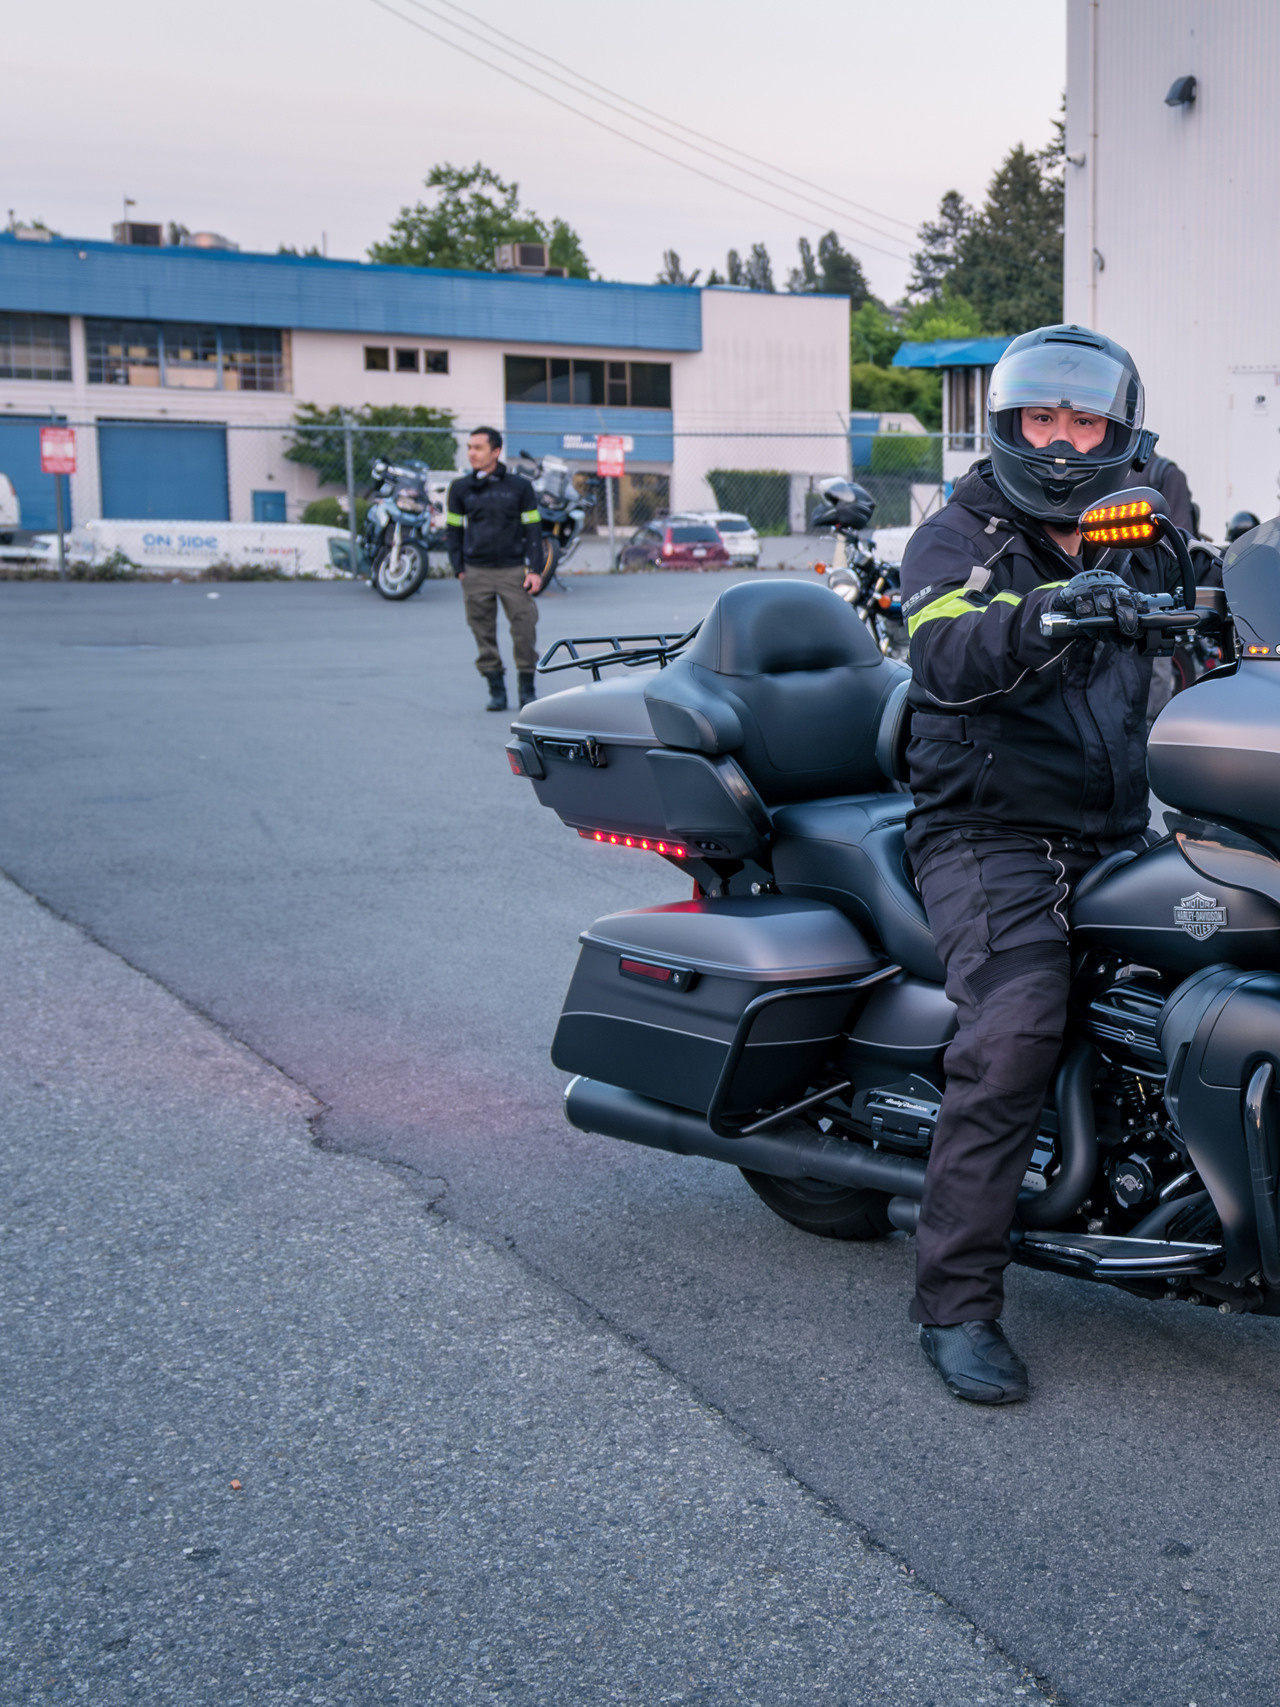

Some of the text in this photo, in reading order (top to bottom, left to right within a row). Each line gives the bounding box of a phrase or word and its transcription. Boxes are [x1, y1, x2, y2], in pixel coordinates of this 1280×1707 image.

[142, 533, 171, 547] ON
[1185, 897, 1211, 909] MOTOR
[1176, 910, 1223, 922] HARLEY-DAVIDSON
[1187, 924, 1212, 936] CYCLES
